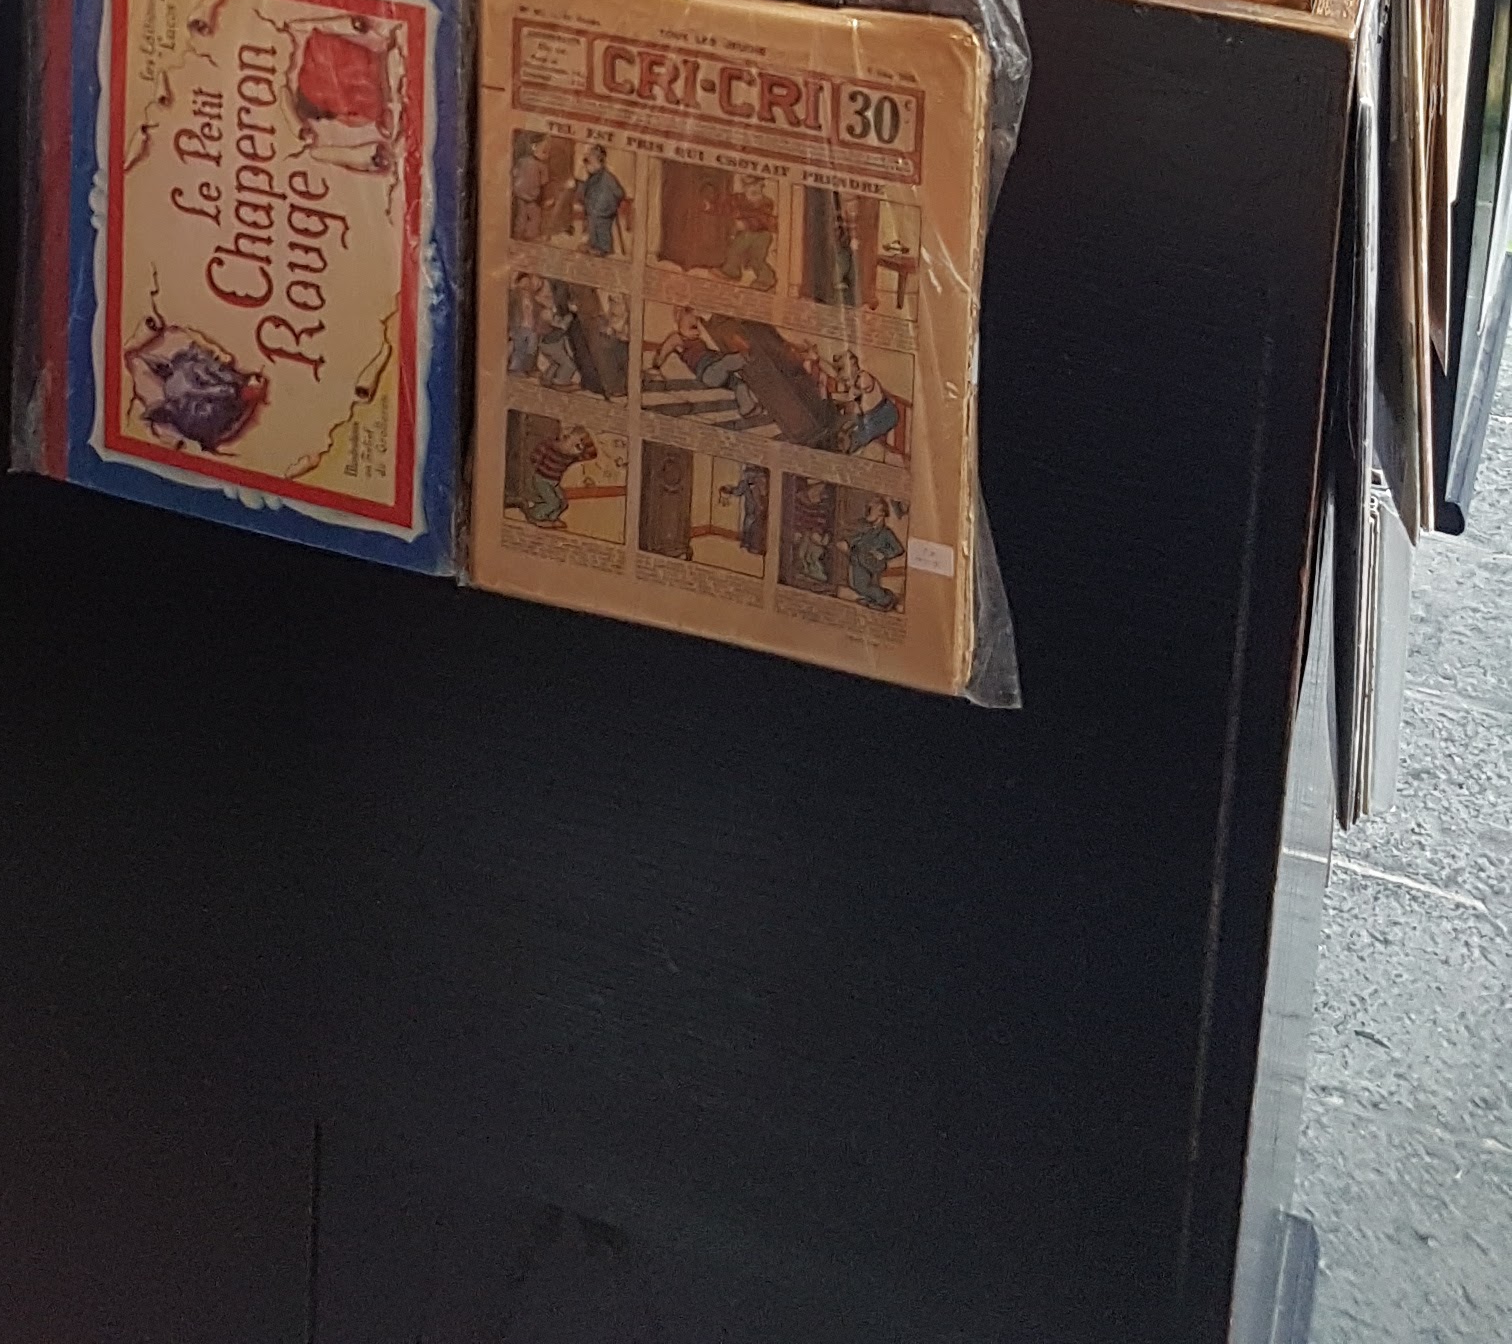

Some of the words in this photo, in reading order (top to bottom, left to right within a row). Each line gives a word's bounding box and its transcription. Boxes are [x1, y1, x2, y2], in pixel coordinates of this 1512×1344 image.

[174, 84, 225, 165] Petit
[602, 45, 823, 131] CRI-CRI
[846, 90, 901, 144] 30
[204, 38, 287, 310] Chaperon
[547, 121, 575, 136] TEL
[586, 127, 615, 143] EST
[626, 137, 663, 155] PRIS
[674, 146, 705, 162] QUI
[716, 154, 789, 179] CROYAIT
[801, 171, 887, 195] PRENDRE
[170, 179, 222, 226] Le
[255, 168, 351, 382] Rouge
